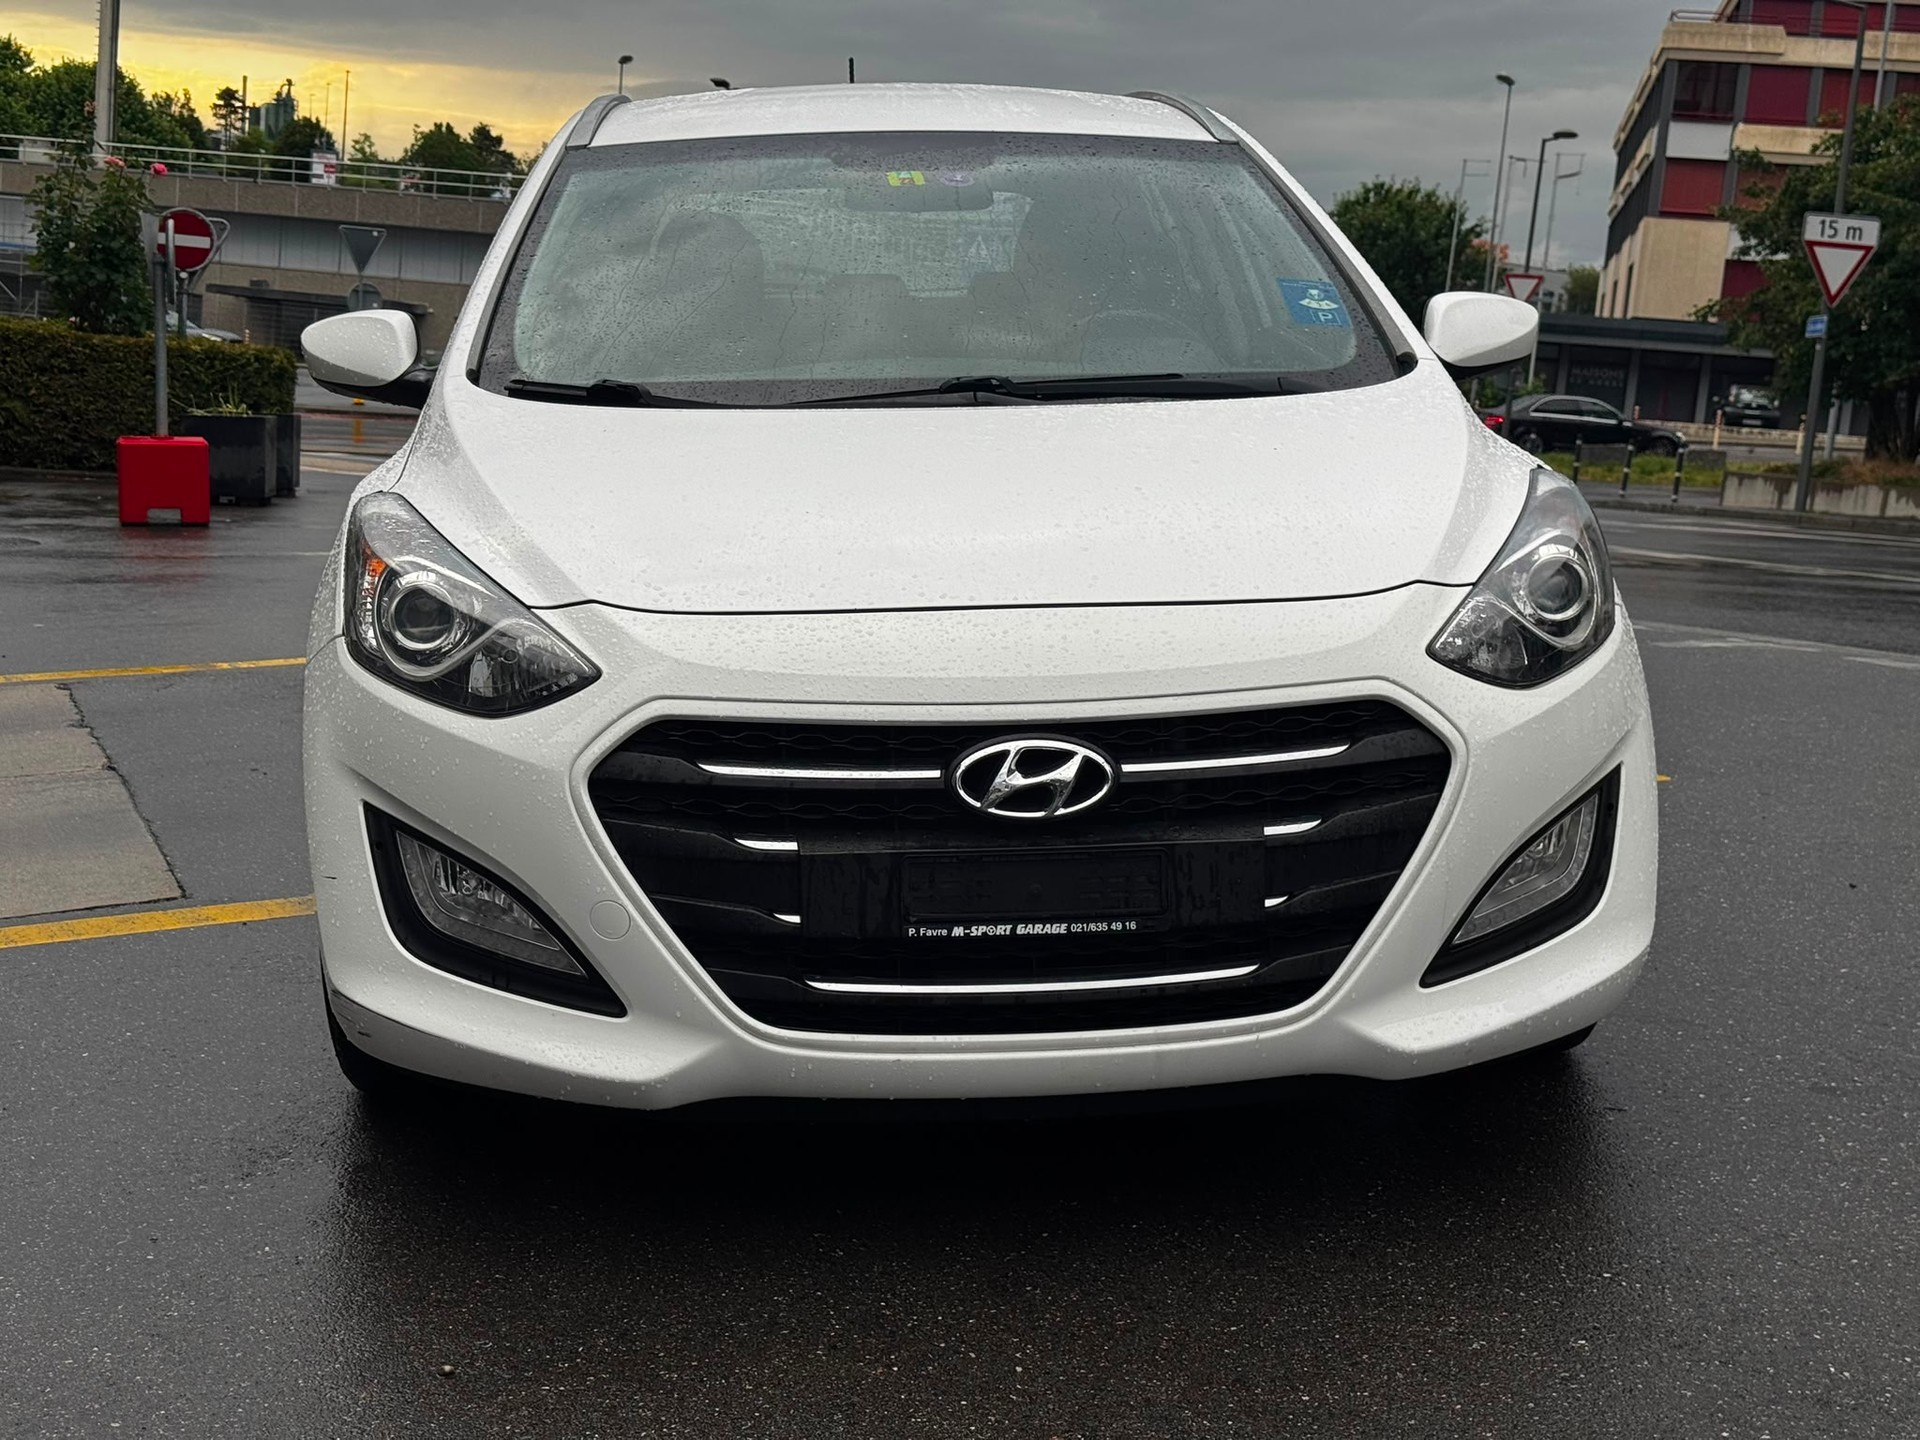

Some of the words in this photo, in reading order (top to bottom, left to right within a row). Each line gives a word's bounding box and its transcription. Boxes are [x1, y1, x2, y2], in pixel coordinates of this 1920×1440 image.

[1819, 219, 1839, 239] 15
[1845, 225, 1863, 241] m
[1318, 312, 1334, 322] P
[1571, 367, 1624, 379] MAISONS
[908, 928, 917, 937] P.
[920, 927, 948, 937] Favre
[951, 925, 1013, 937] M-SPORT
[1016, 923, 1068, 935] GARAGE
[1070, 922, 1108, 933] 021/635
[1110, 921, 1123, 931] 49
[1125, 921, 1137, 930] 16
